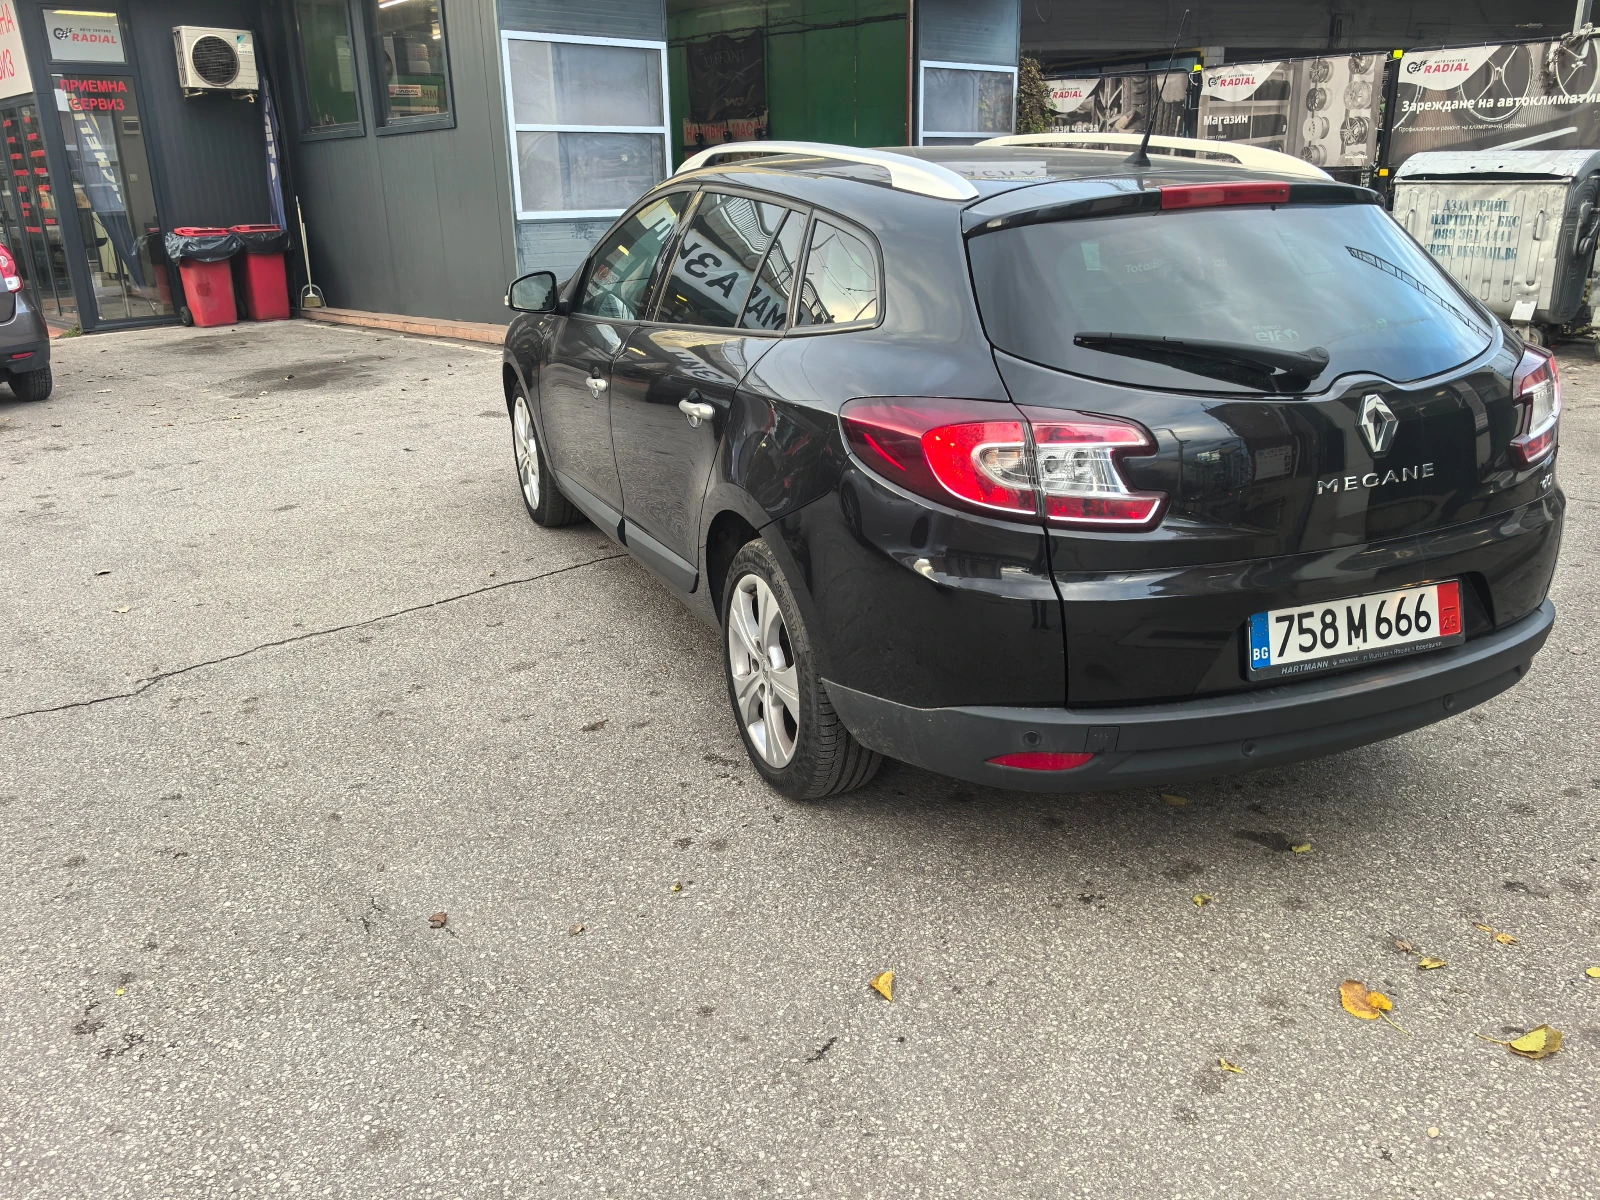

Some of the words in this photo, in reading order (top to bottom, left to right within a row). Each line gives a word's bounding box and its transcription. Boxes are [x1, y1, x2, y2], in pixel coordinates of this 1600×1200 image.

[72, 33, 117, 44] RADIAL
[1424, 62, 1470, 74] RADIAL
[60, 79, 127, 92] ПРИЕМНА
[1220, 77, 1256, 87] RADIAL
[1052, 90, 1082, 99] RADIAL
[71, 98, 125, 111] СЕРВИЗ
[1402, 99, 1475, 114] Зареждане
[1478, 98, 1494, 108] на
[1204, 114, 1249, 126] Магазин
[1497, 216, 1520, 228] БКС
[1433, 229, 1456, 240] 089
[1459, 229, 1480, 240] 361
[1317, 462, 1435, 495] MEGANE
[1276, 608, 1339, 658] 758
[1375, 594, 1432, 640] 666
[1442, 616, 1456, 630] 25
[1253, 647, 1269, 661] BG
[1282, 660, 1329, 675] HARTMANN
